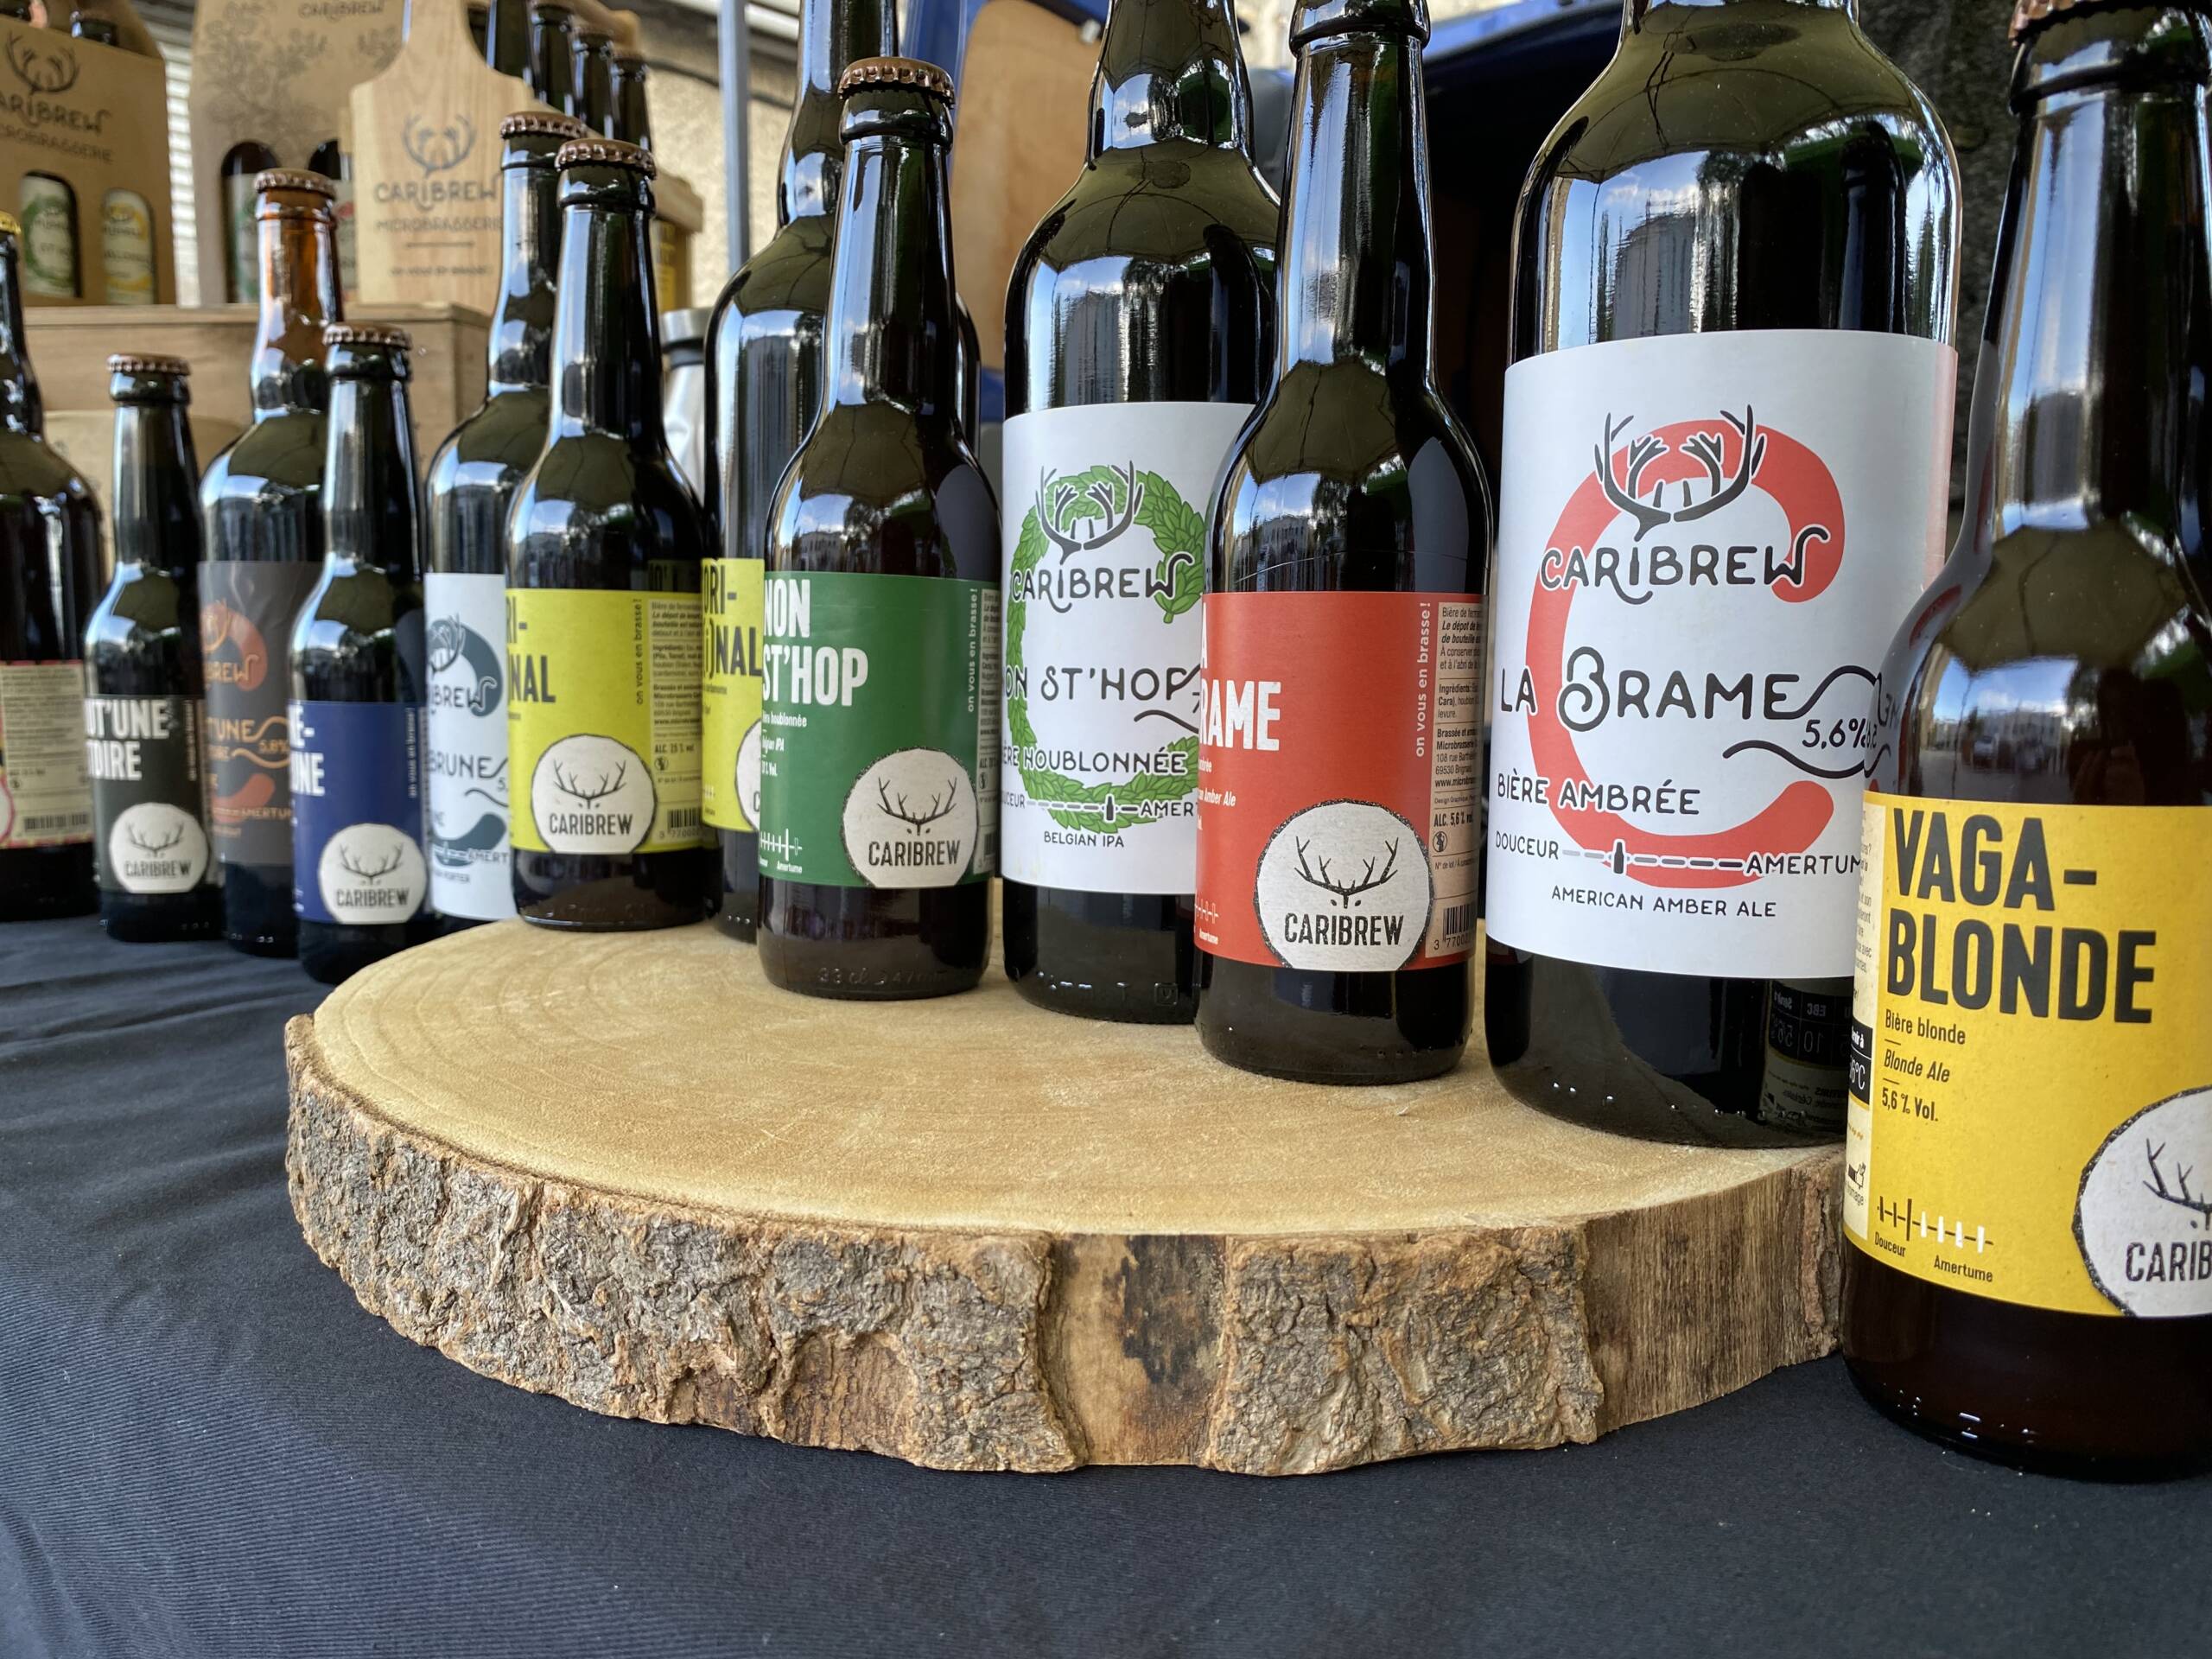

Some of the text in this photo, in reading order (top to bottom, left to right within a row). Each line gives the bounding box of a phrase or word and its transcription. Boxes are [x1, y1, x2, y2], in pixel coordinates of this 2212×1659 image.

[1541, 526, 1829, 605] CARIBREW
[1013, 554, 1192, 613] CARIBREW
[1442, 607, 1459, 618] Bière
[1442, 621, 1451, 631] Le
[1442, 634, 1451, 644] de
[636, 644, 643, 658] en
[969, 641, 976, 657] en
[761, 645, 868, 707] ST'HOP
[1440, 660, 1446, 669] et
[1040, 665, 1200, 701] ST'HOP
[1419, 668, 1427, 689] en
[1501, 646, 1832, 733] LA BRAME
[636, 690, 643, 705] on
[968, 696, 975, 712] on
[1417, 694, 1427, 731] vous
[1437, 728, 1460, 738] Brassée
[1802, 718, 1866, 749] 5,6%
[1416, 736, 1424, 757] on
[1024, 747, 1186, 773] HOUBLONNÉE
[1435, 765, 1453, 774] 69530
[1224, 791, 1236, 807] Ale
[1497, 768, 1700, 815] BIÈRE AMBRÉE
[550, 812, 632, 836] CARIBREW
[1451, 813, 1459, 827] 5,6
[1044, 831, 1124, 848] BELGIAN IPA
[1496, 830, 1559, 860] DOUCEUR
[868, 840, 960, 867] CARIBREW
[1893, 807, 2097, 911] VAGA-
[127, 861, 192, 878] CARIBREW
[336, 887, 410, 908] CARIBREW
[1552, 885, 1777, 918] AMERICAN AMBER ALE
[1284, 912, 1404, 946] CARIBREW
[1887, 907, 2157, 1024] BLONDE
[1885, 1008, 1966, 1045] Bière blonde
[1884, 1049, 1950, 1083] Blonde Ale
[1882, 1087, 1938, 1122] 5,6 % Vol.
[1874, 1231, 1993, 1282] Douceur Amertume
[2126, 1241, 2212, 1281] CARIB
